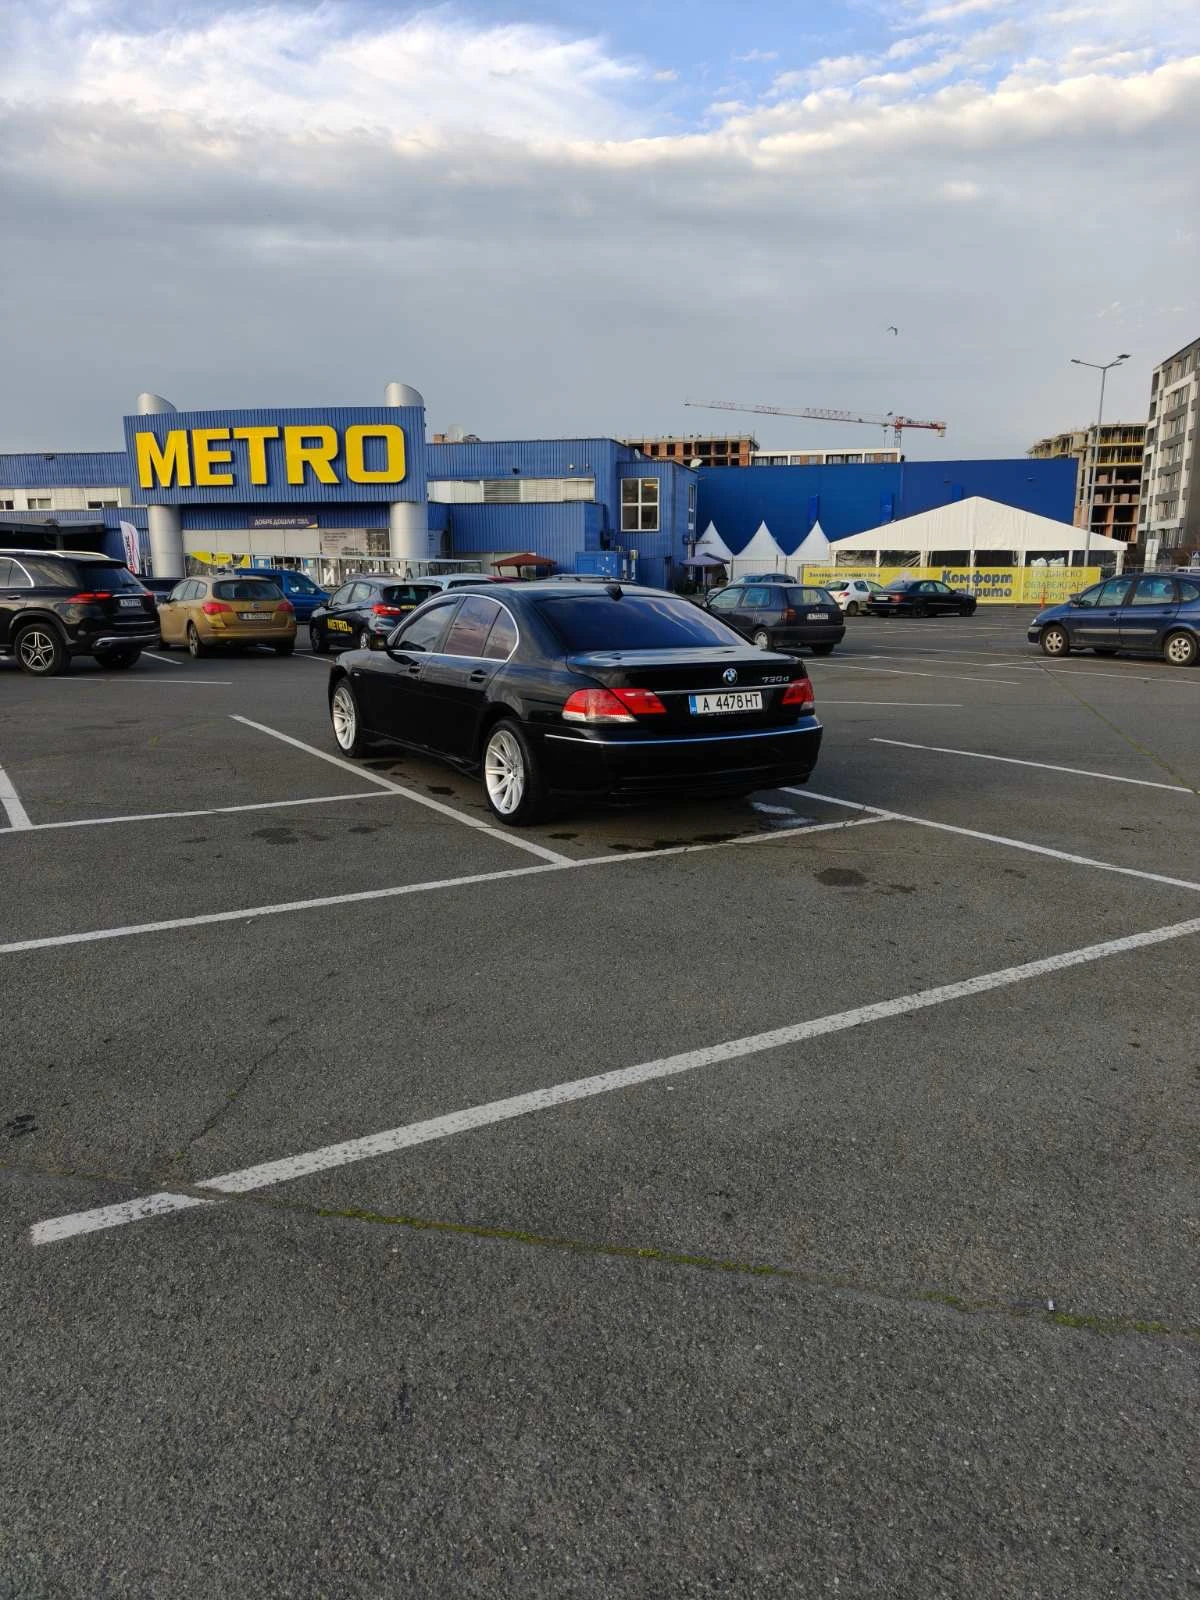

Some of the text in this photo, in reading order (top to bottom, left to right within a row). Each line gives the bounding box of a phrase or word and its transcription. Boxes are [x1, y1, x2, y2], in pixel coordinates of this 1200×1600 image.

[135, 424, 406, 488] METRO
[942, 569, 1013, 587] Комфорт
[761, 675, 790, 683] 730d
